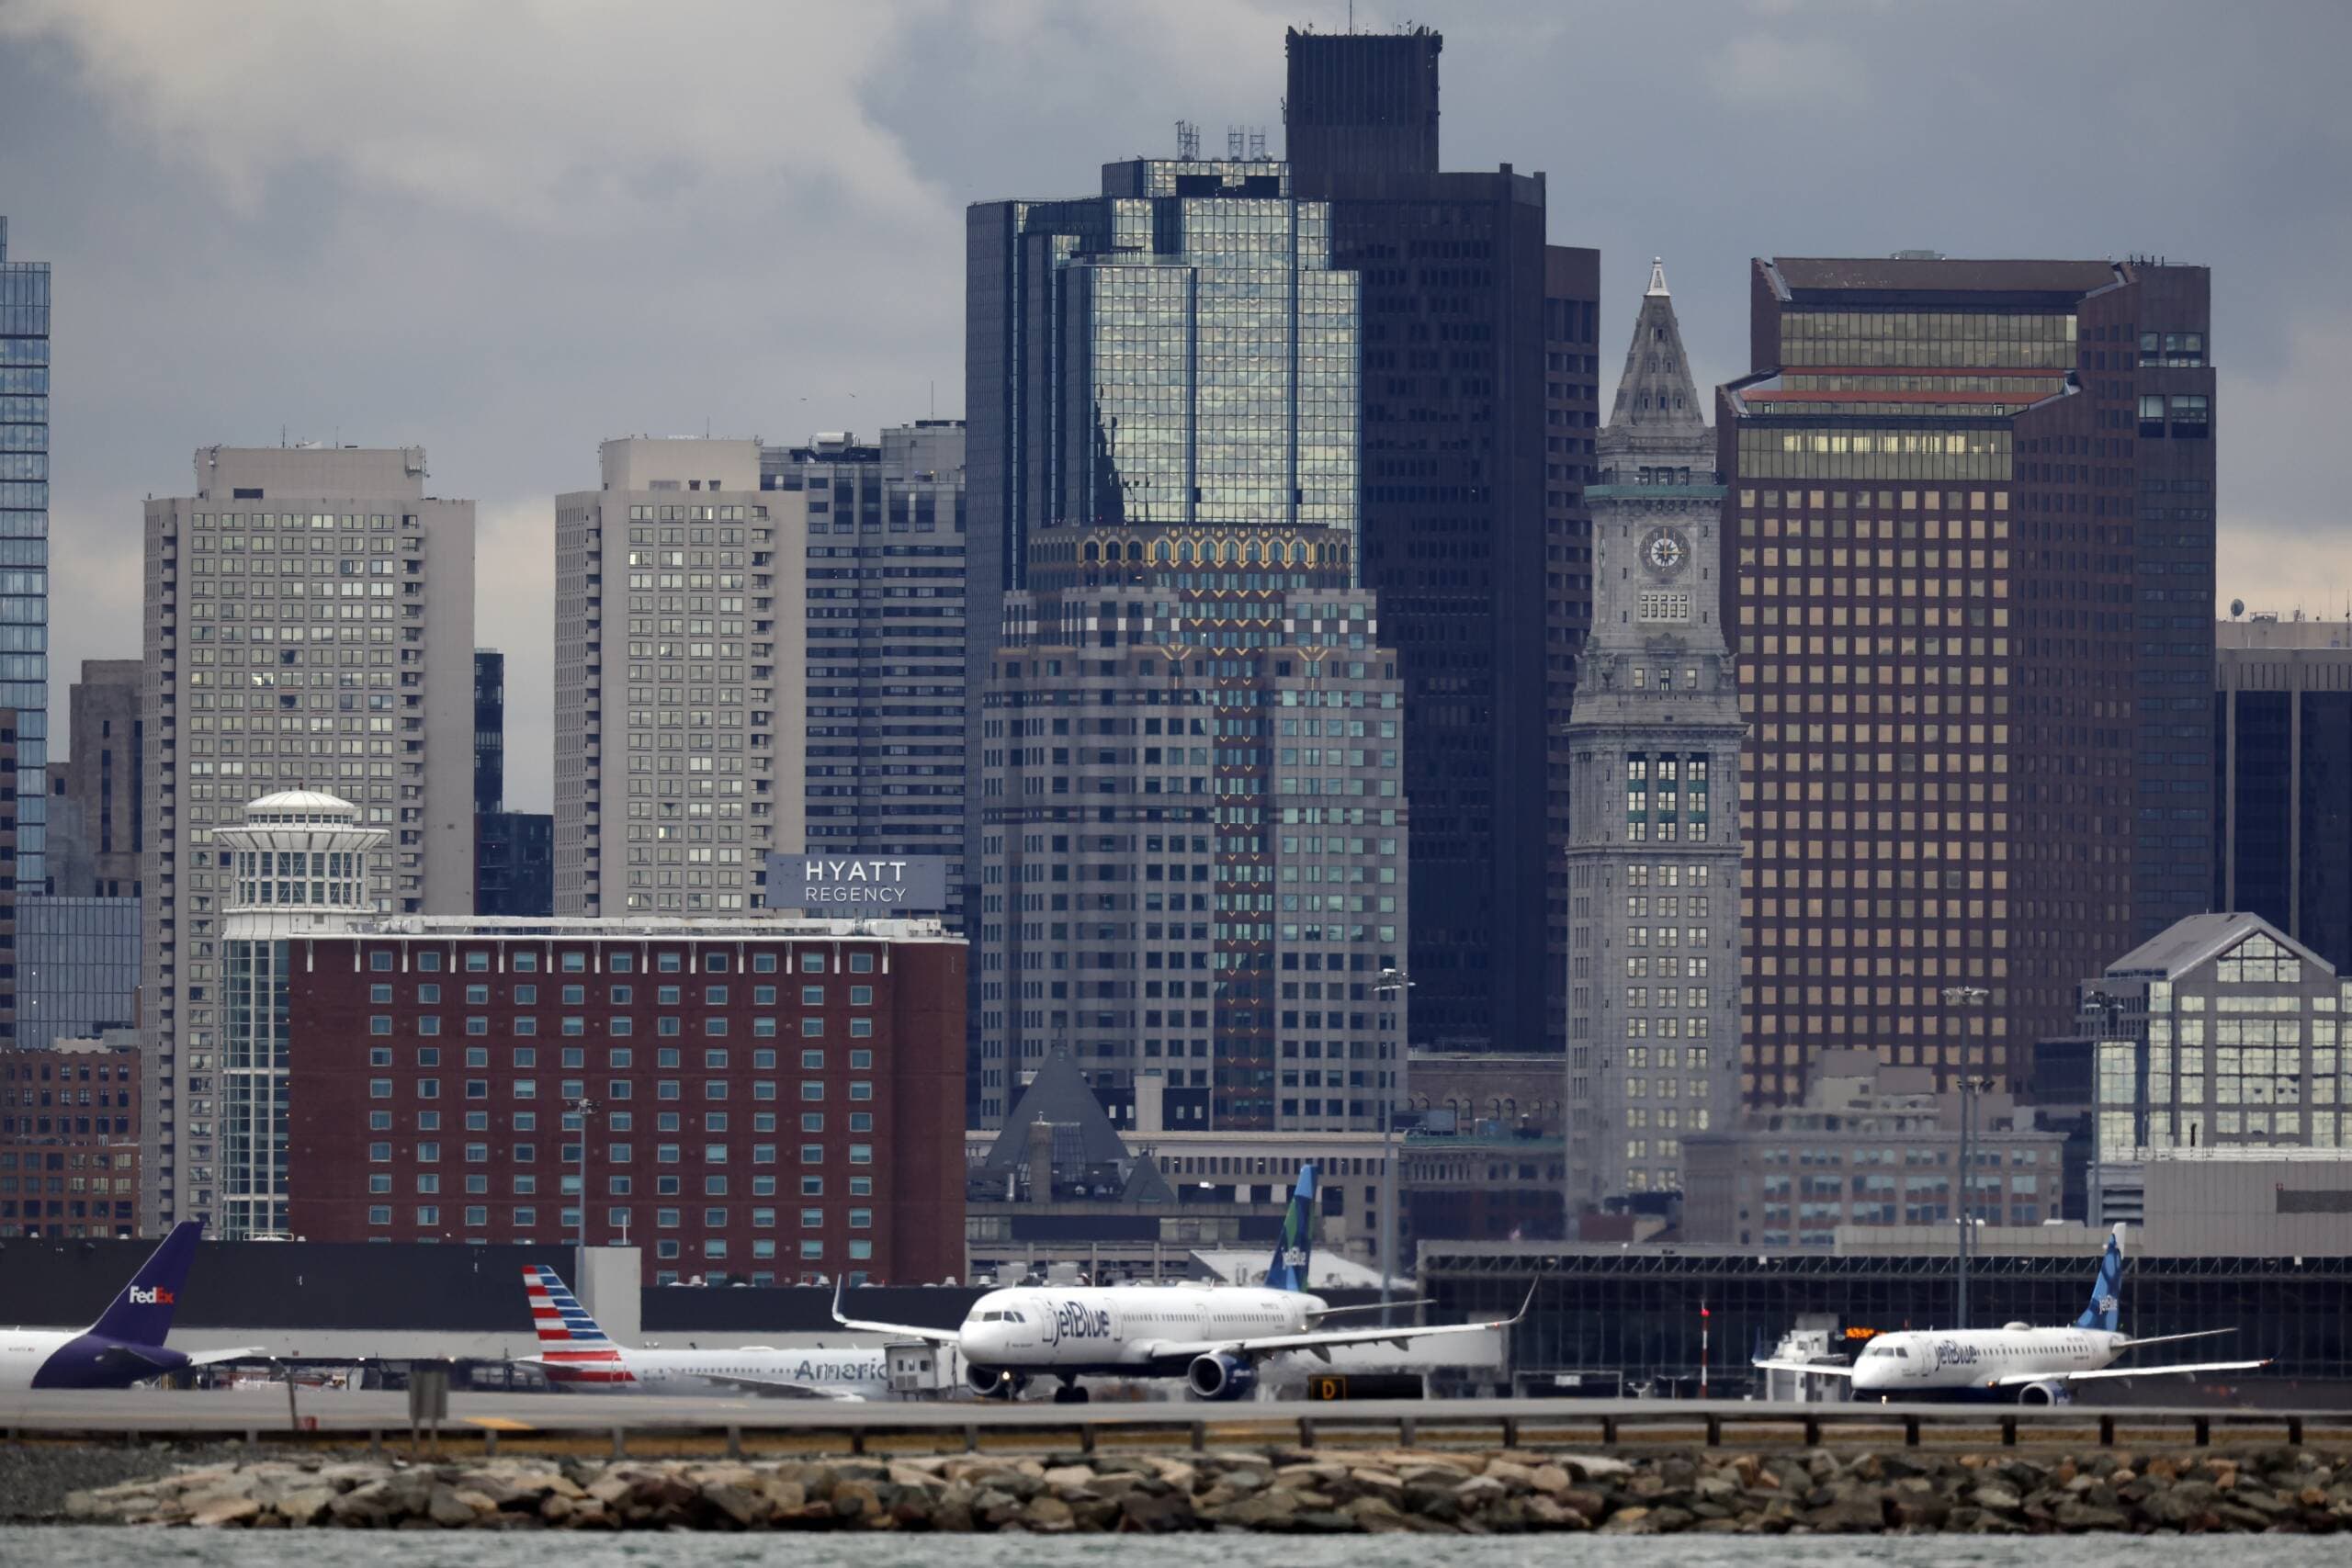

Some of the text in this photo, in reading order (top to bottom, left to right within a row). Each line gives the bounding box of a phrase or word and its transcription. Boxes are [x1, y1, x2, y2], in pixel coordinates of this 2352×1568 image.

[806, 861, 906, 882] HYATT
[805, 887, 907, 902] REGENCY
[1281, 1246, 1306, 1269] jetBlue
[130, 1285, 174, 1303] FedEx
[1048, 1301, 1110, 1347] jetBlue
[1932, 1339, 1977, 1371] jetBlue
[1323, 1380, 1336, 1400] D
